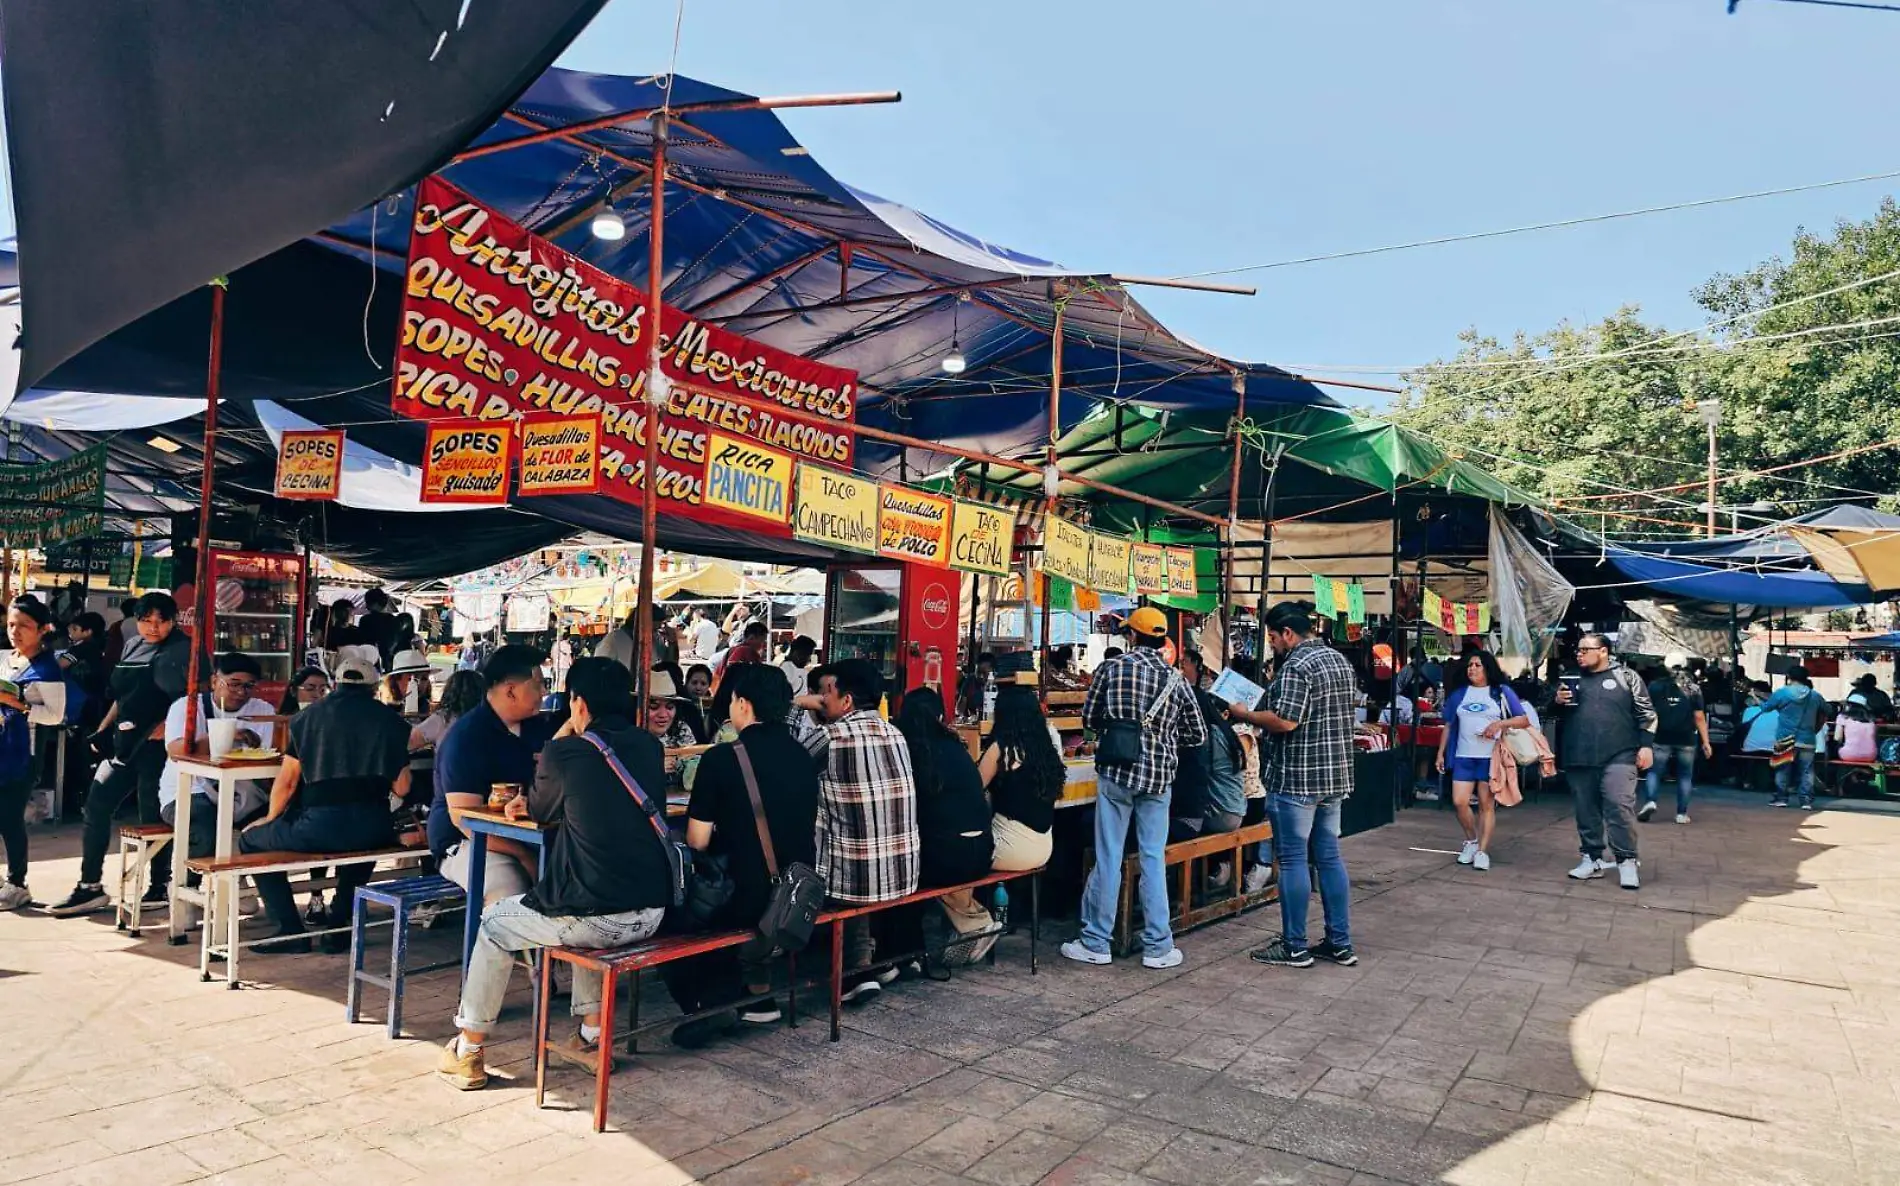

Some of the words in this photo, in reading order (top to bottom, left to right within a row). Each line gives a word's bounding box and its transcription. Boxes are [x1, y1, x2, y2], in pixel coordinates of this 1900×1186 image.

[415, 203, 646, 344] Antojitos
[657, 321, 852, 420] Mexicanos
[431, 432, 502, 463] SOPES
[524, 427, 590, 449] Quesadillas
[758, 411, 850, 462] TLACOYOS
[285, 439, 336, 459] SOPES
[525, 453, 538, 466] de
[538, 449, 572, 465] FLOR
[574, 449, 591, 463] de
[715, 444, 774, 472] RICA
[436, 456, 502, 471] SENCILLOS
[524, 468, 591, 483] CALABAZA
[282, 474, 331, 489] CECINA
[443, 470, 503, 495] guisado
[709, 464, 783, 515] PANCITA
[822, 476, 856, 499] TACO
[883, 492, 946, 521] Quesadillas
[799, 502, 874, 544] CAMPECHANO
[977, 511, 1001, 532] TACO
[882, 532, 897, 548] de
[898, 536, 938, 558] POLLO
[924, 598, 948, 614] Coca-Cola
